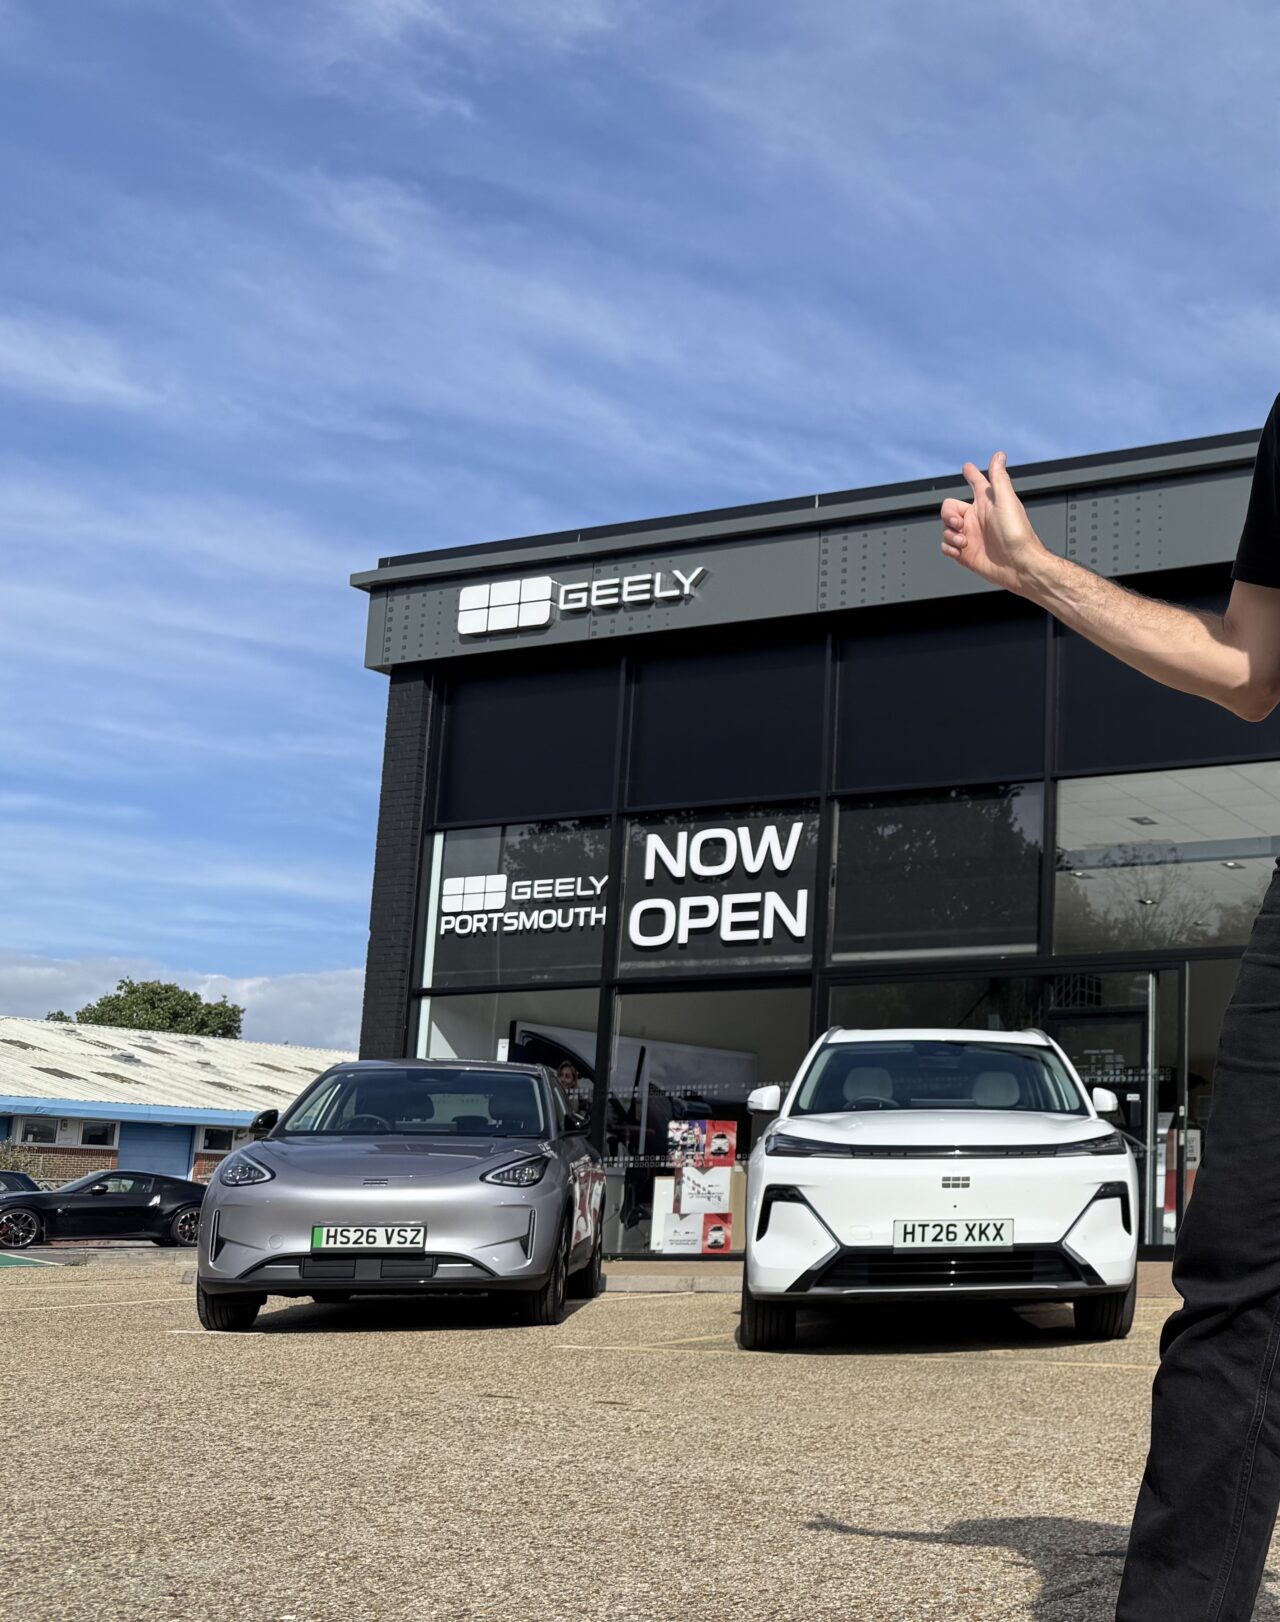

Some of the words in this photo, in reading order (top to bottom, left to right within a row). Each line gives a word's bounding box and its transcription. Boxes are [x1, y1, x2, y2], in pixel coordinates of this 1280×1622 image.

[558, 566, 704, 610] GEELY
[644, 821, 804, 880] NOW
[510, 874, 609, 901] GEELY
[439, 905, 607, 935] PORTSMOUTH
[628, 889, 808, 947] OPEN
[325, 1228, 377, 1245] HS26
[384, 1228, 422, 1245] VSZ
[903, 1223, 957, 1243] HT26
[964, 1222, 1004, 1242] XKX
